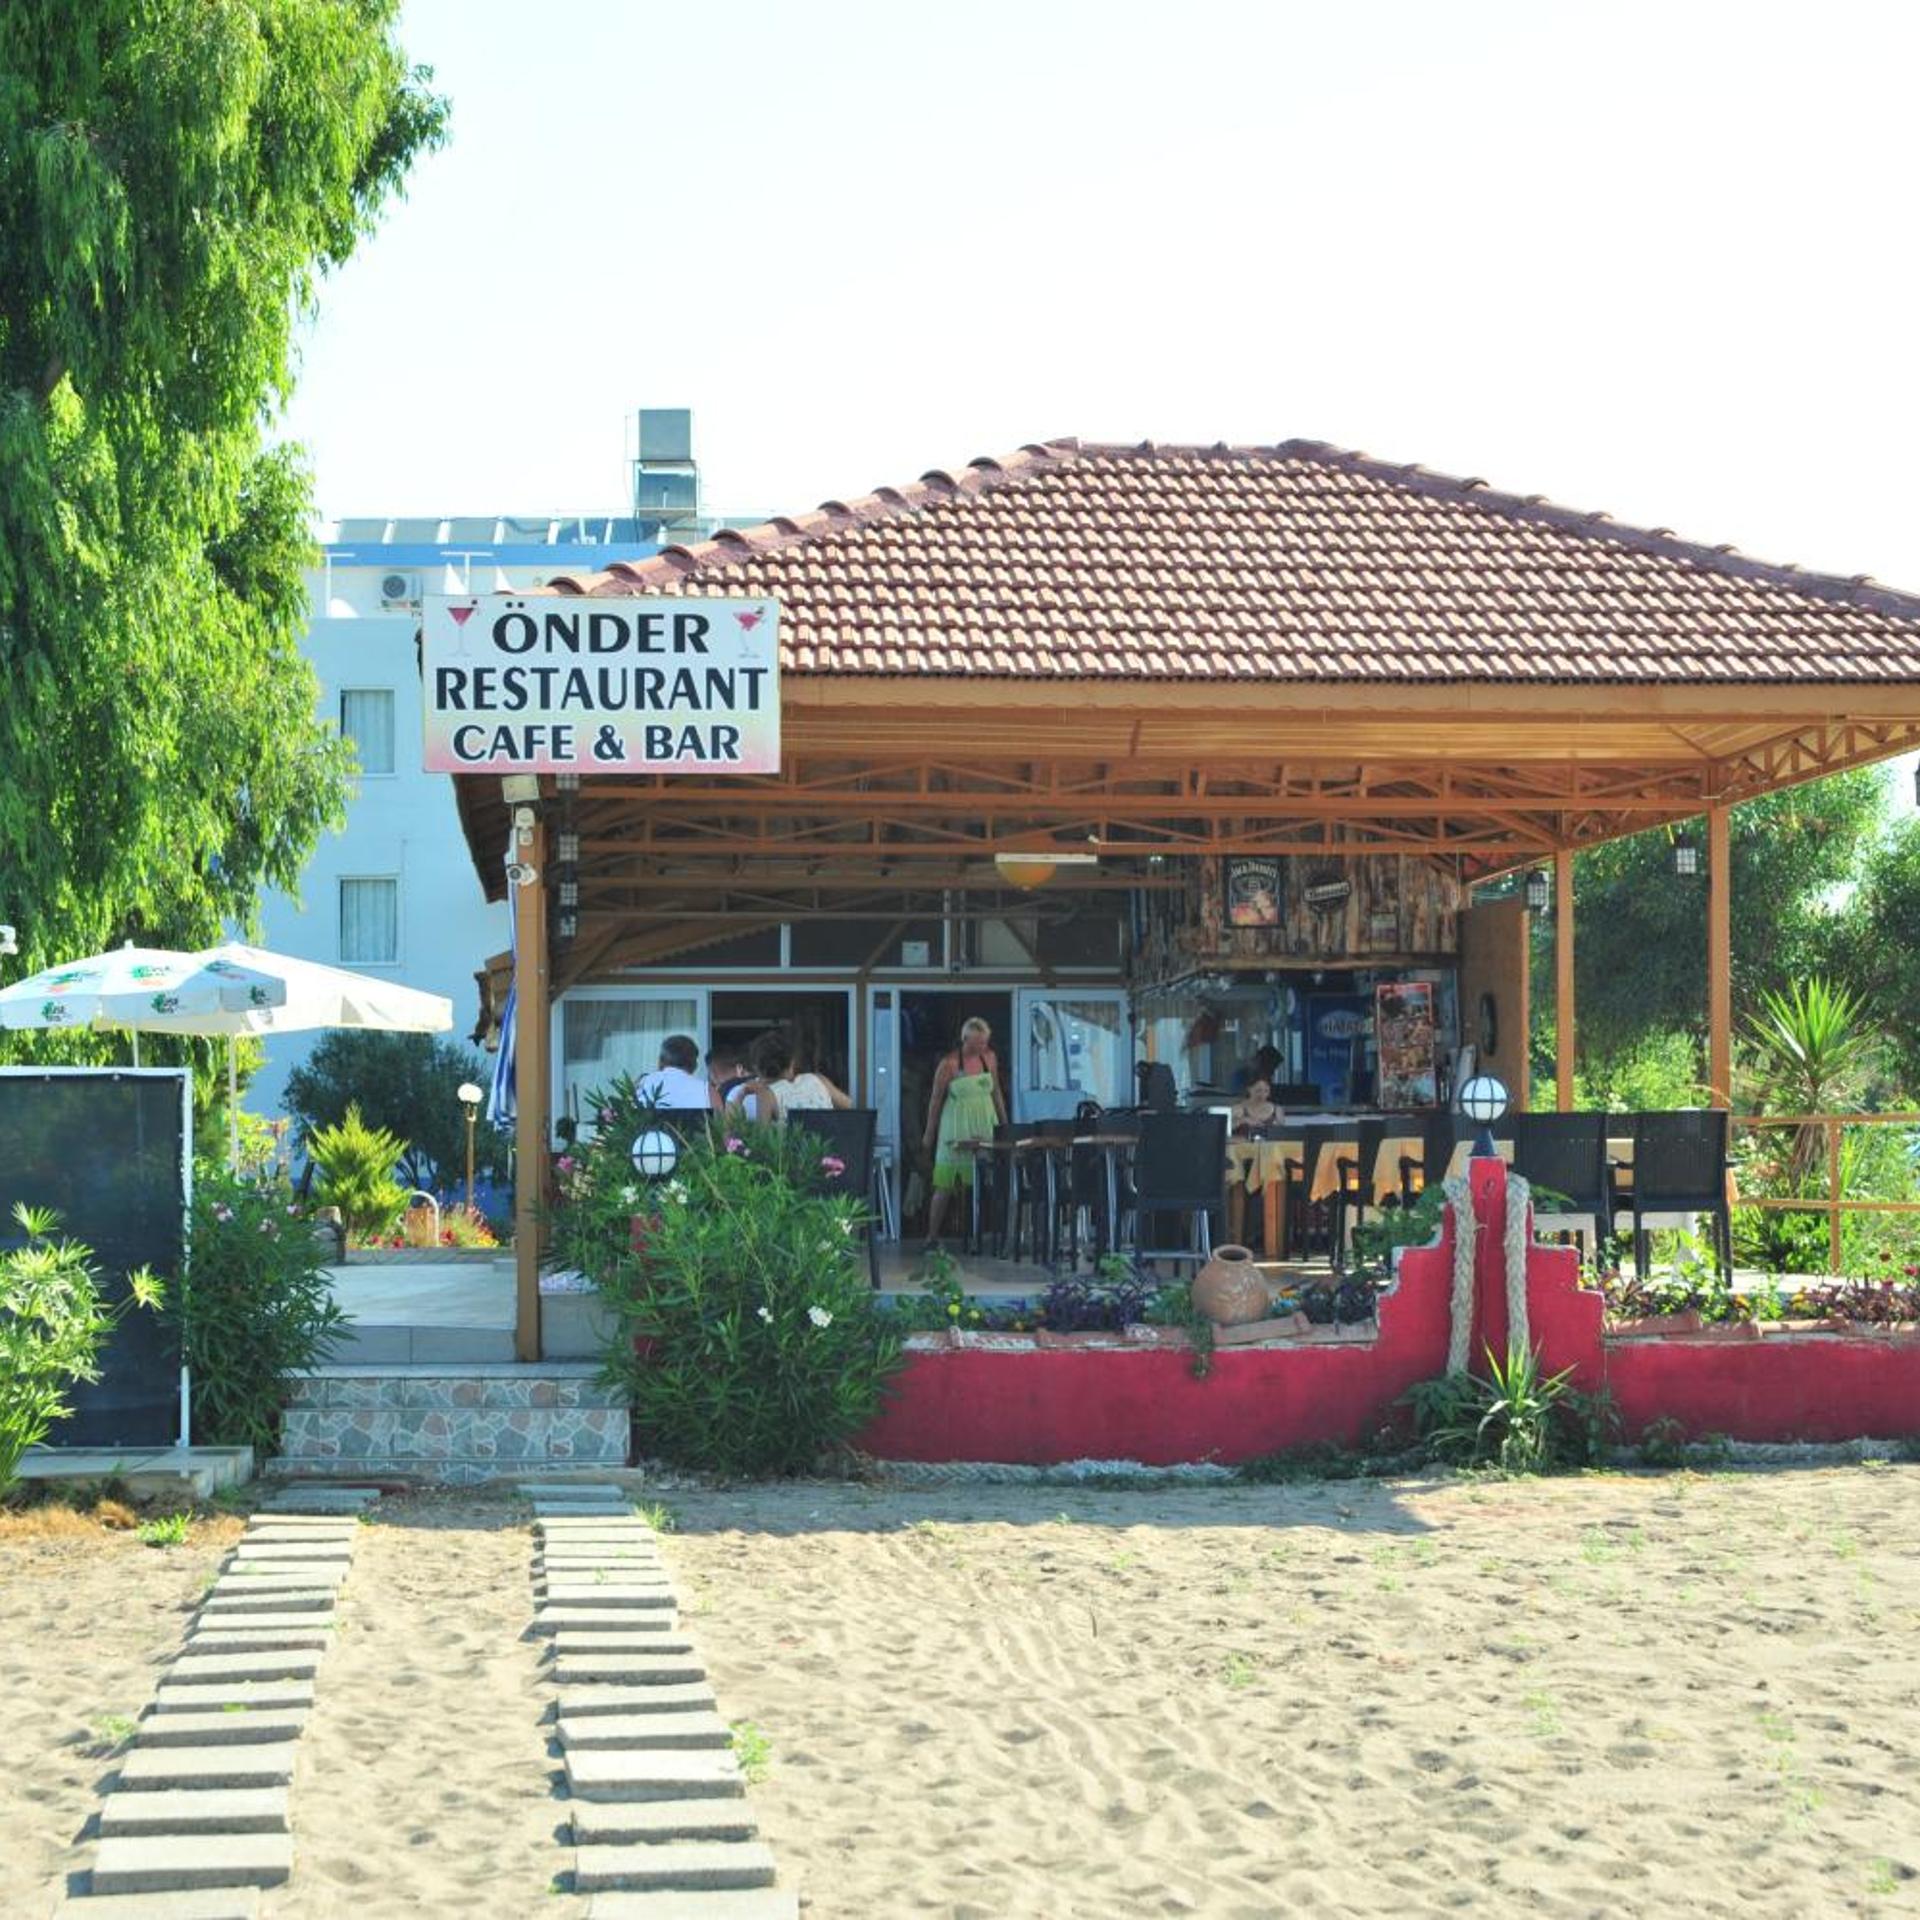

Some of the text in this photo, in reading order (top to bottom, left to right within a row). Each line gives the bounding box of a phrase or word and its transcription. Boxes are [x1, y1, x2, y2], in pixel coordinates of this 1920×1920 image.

[492, 601, 710, 654] ÖNDER
[436, 667, 768, 710] RESTAURANT
[453, 725, 740, 760] CAFE & BAR
